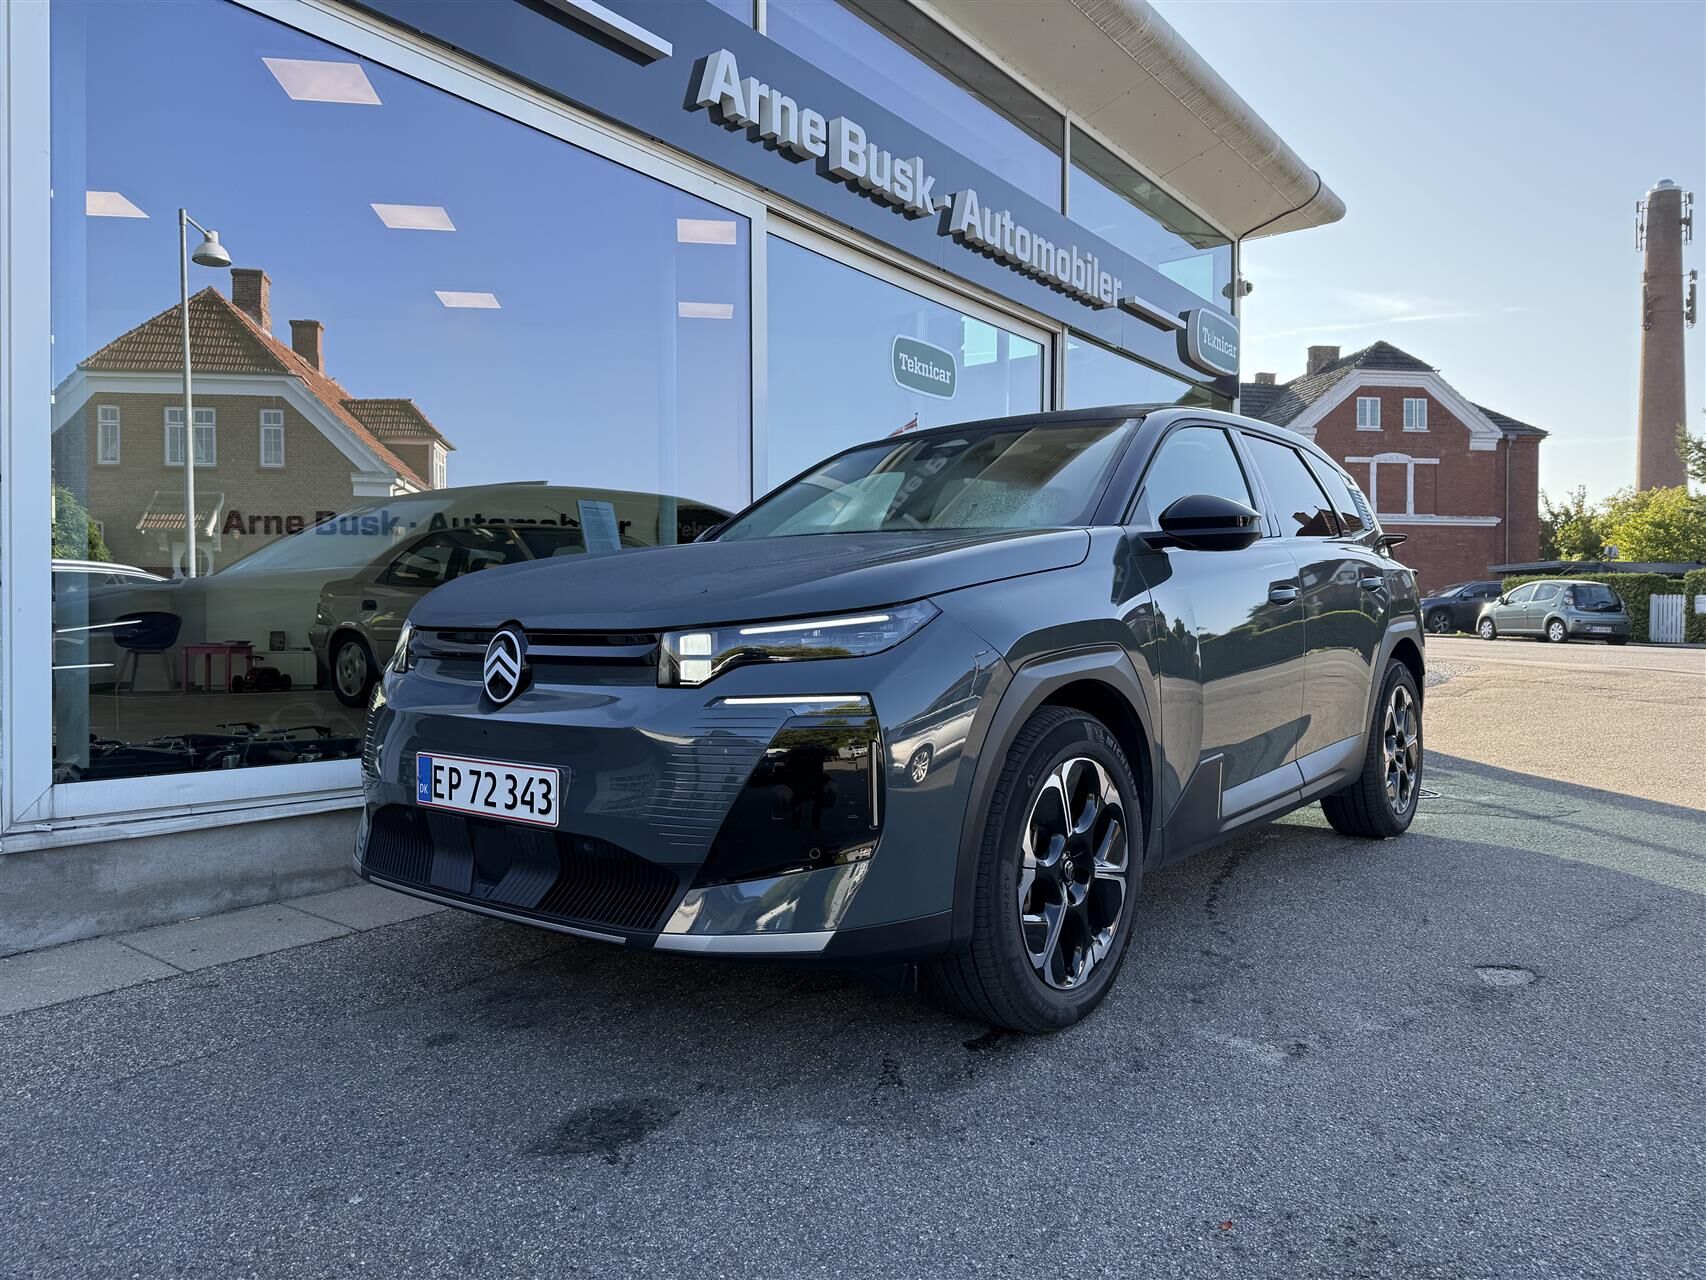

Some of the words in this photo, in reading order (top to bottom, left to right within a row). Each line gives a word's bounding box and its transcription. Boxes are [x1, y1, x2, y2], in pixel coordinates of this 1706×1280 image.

[695, 48, 827, 158] Arne
[829, 116, 936, 216] Busk
[949, 188, 1122, 309] Automobiler
[1202, 326, 1237, 359] Teknicar
[899, 352, 952, 384] Teknicar
[222, 510, 305, 535] Arne
[315, 510, 400, 536] Busk
[419, 783, 429, 795] DK
[433, 764, 462, 801] EP
[469, 769, 497, 808] 72
[504, 773, 553, 815] 343
